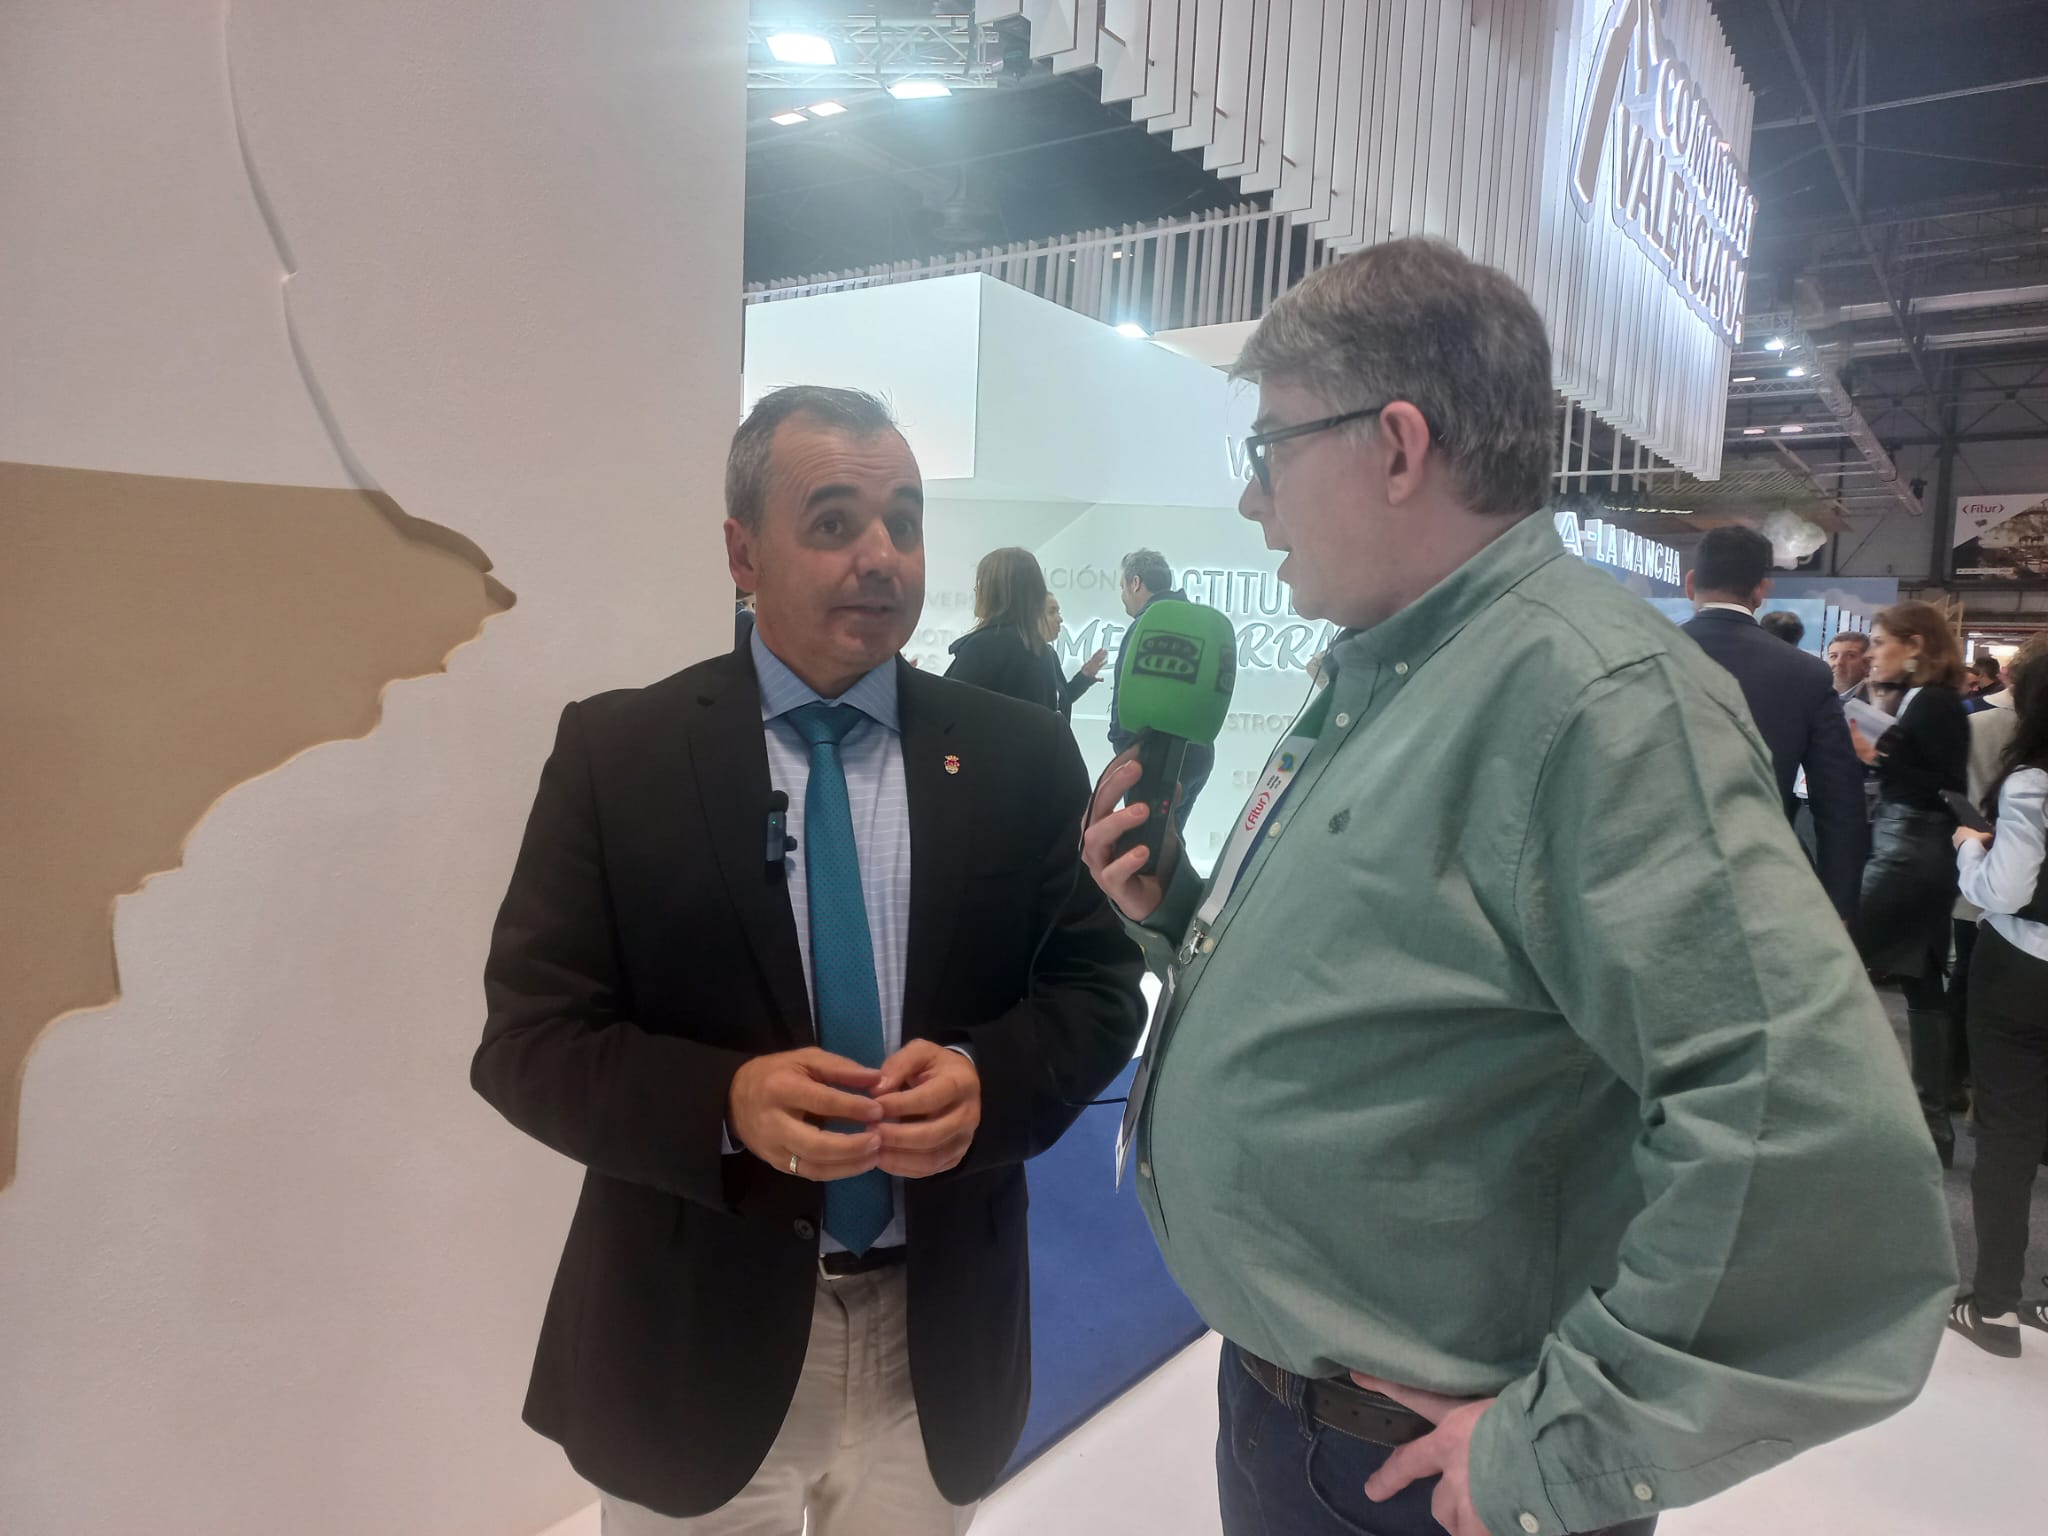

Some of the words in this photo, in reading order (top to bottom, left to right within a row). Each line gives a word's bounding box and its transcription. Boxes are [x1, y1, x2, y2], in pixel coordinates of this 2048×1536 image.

[1616, 104, 1747, 344] VALENCIANA
[1621, 529, 1680, 586] MANCHA
[1171, 569, 1297, 615] CTITU
